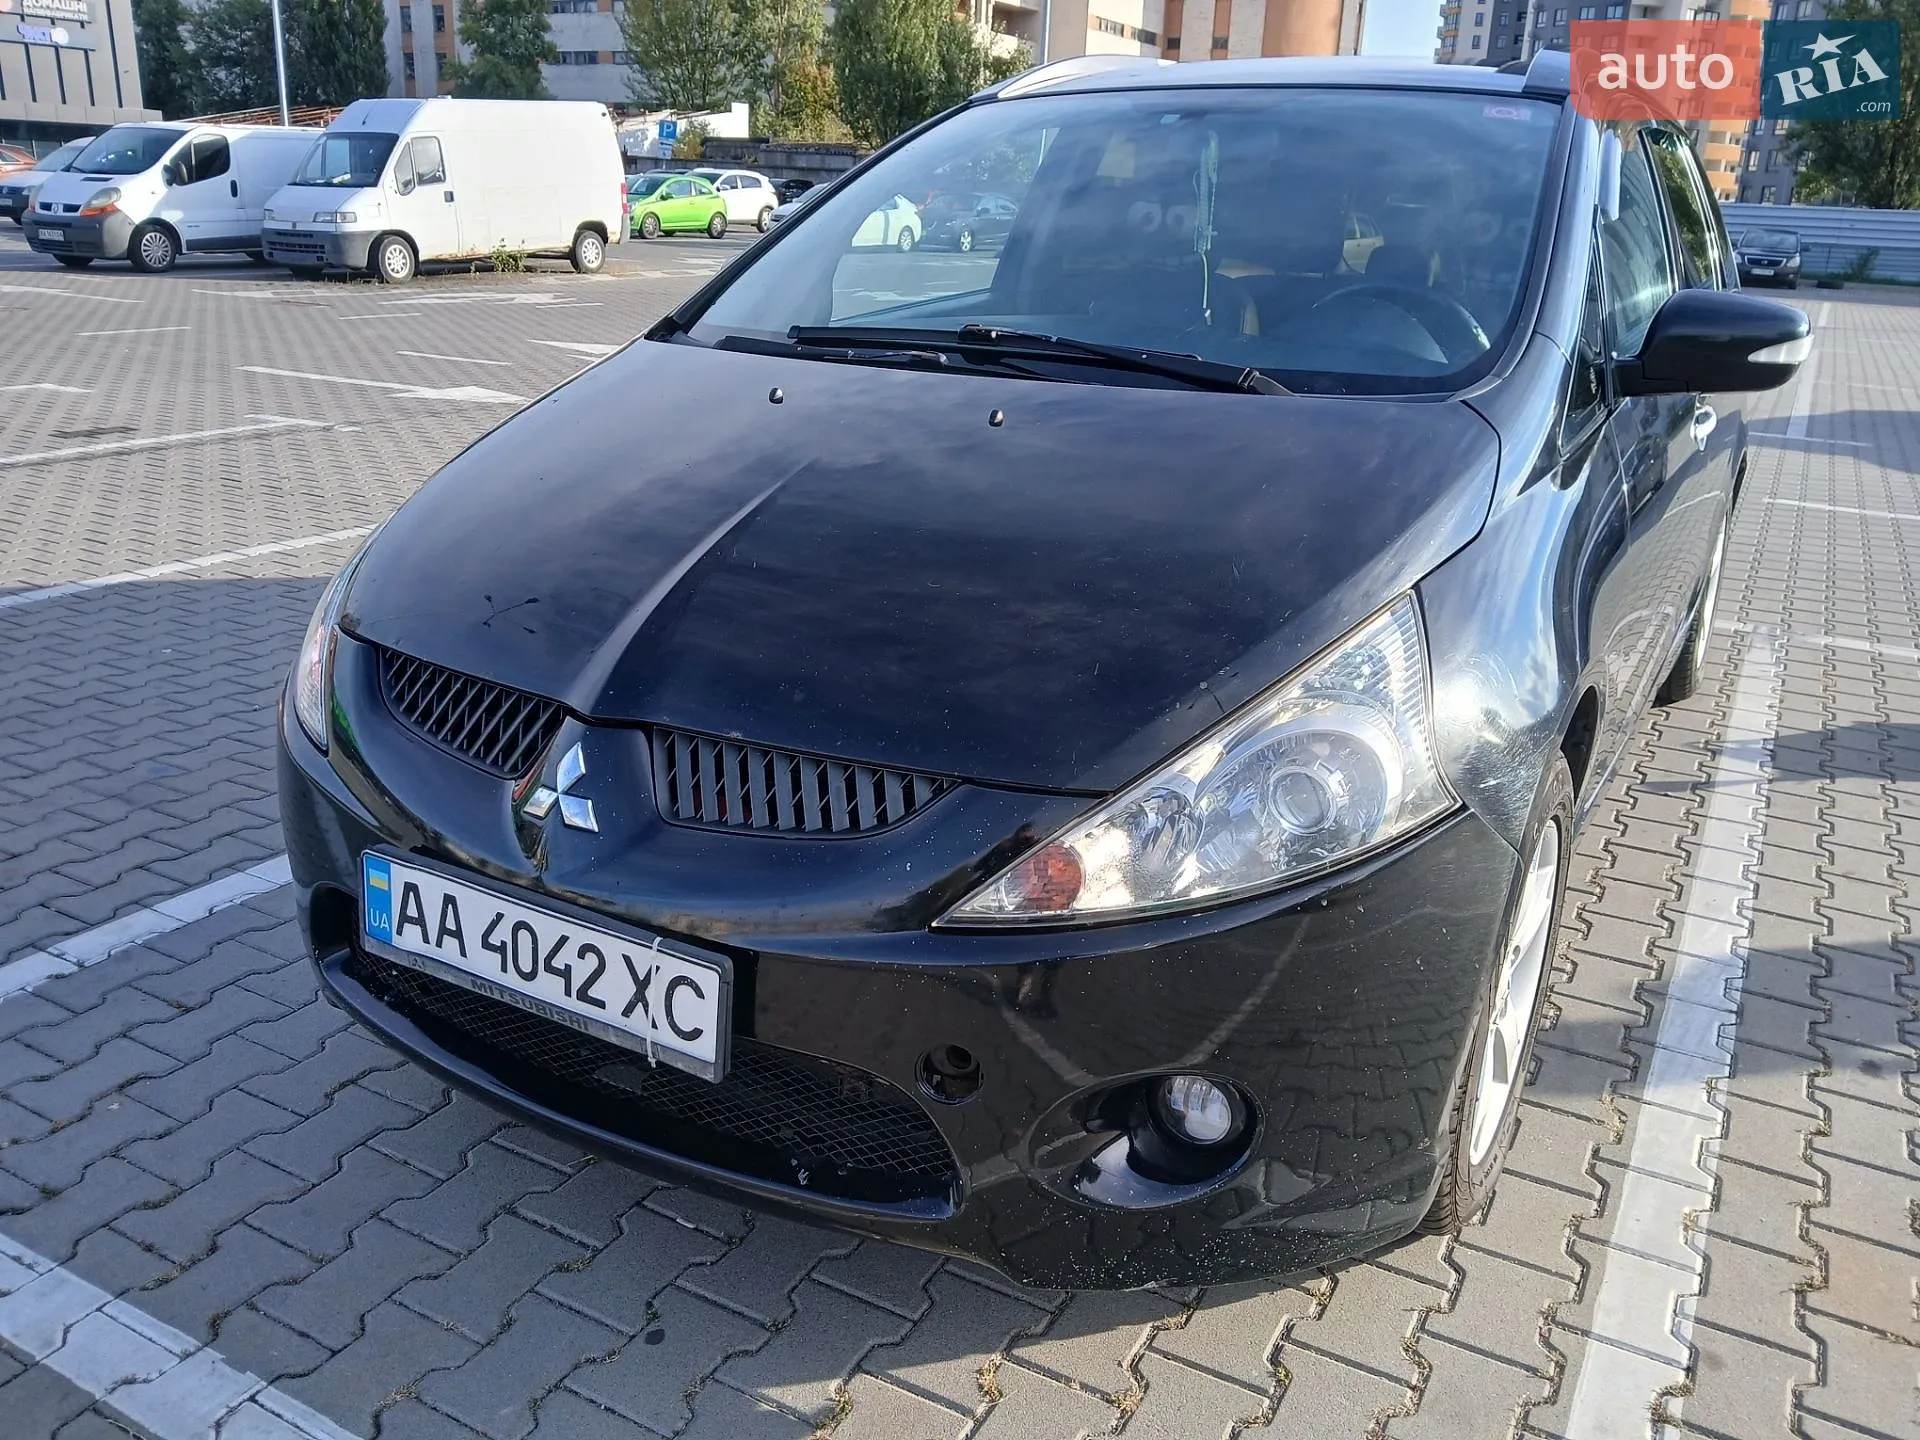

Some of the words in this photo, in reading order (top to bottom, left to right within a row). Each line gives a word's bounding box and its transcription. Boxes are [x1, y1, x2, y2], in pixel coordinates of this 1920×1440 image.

[663, 122, 674, 137] P
[369, 906, 390, 932] UA
[396, 880, 468, 959] AA
[480, 911, 606, 1011] 4042
[620, 952, 706, 1042] XC
[470, 979, 591, 1033] MITSUBISHI
